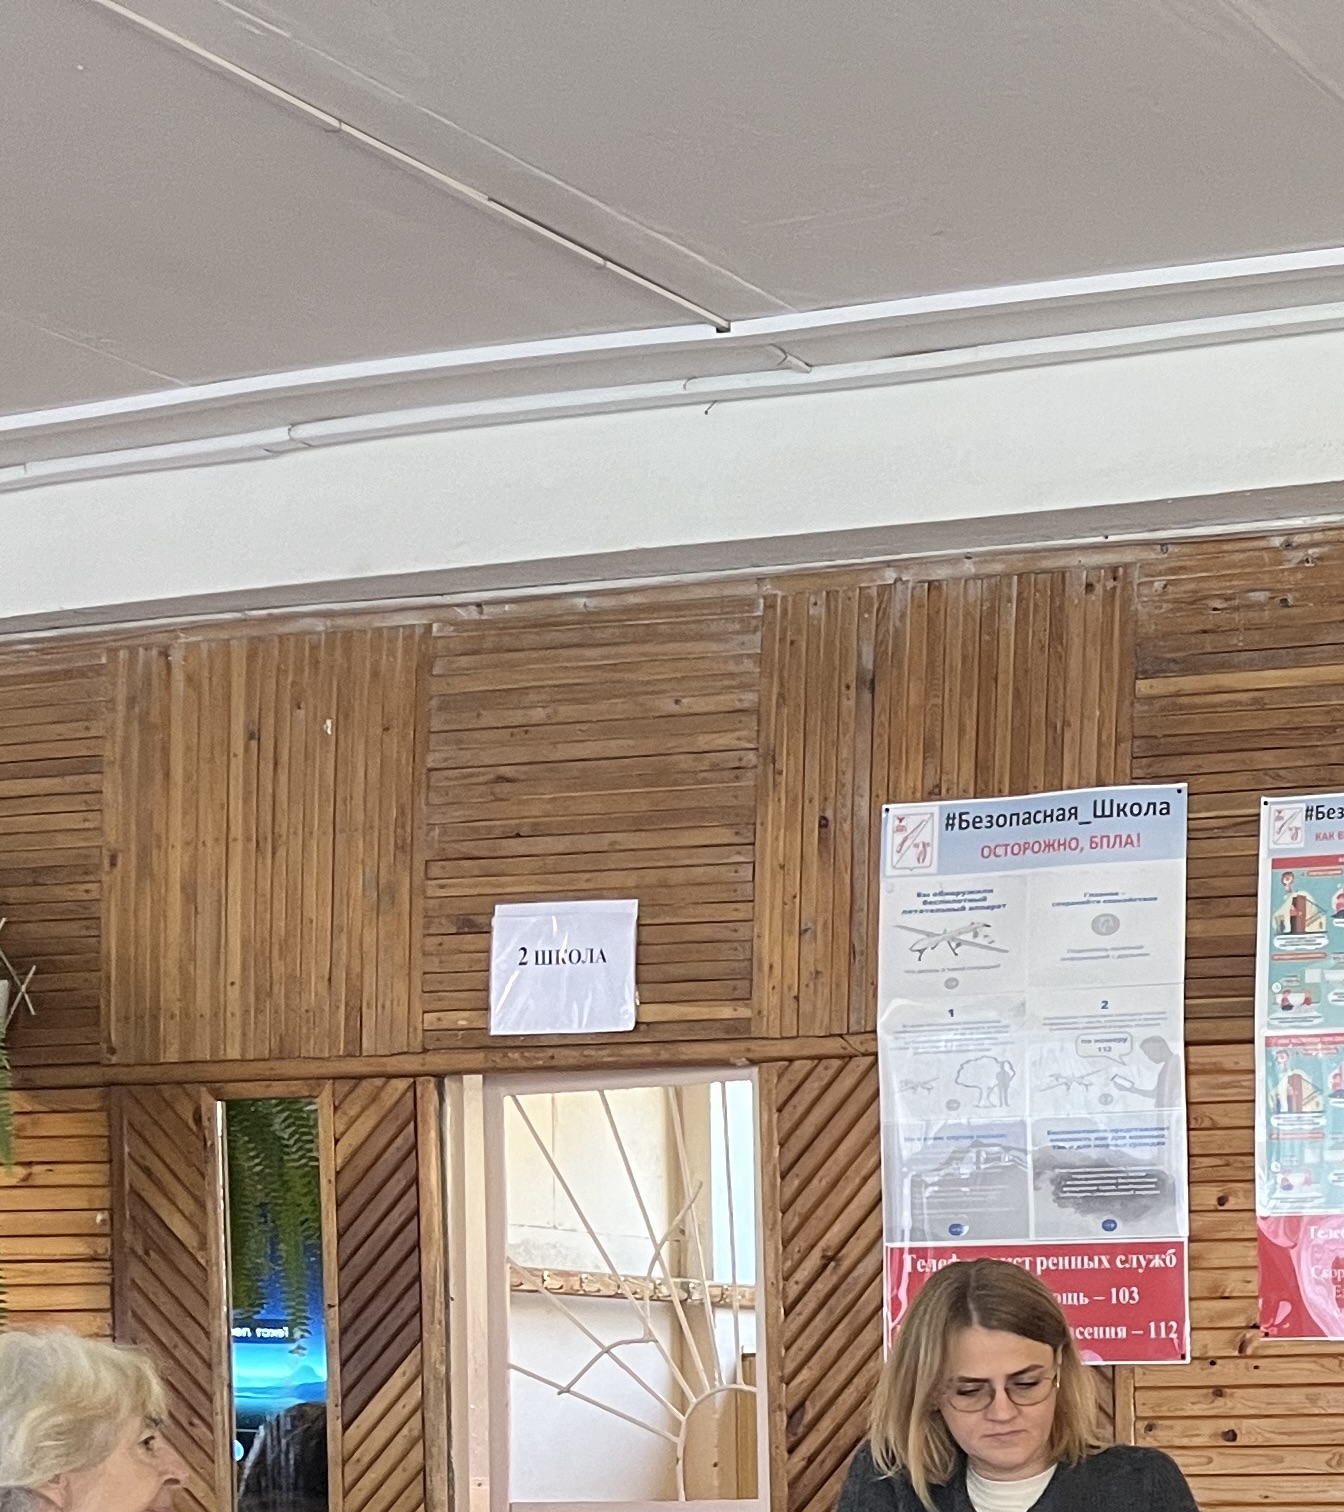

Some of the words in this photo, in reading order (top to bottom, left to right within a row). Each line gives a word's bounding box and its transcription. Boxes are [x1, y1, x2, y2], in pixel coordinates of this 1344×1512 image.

[945, 798, 1171, 831] #Безопасная_Школа
[980, 836, 1084, 859] ОСТОРОЖНО,
[1089, 832, 1141, 850] БПЛА!
[1315, 831, 1335, 842] КАК
[518, 946, 528, 966] 2
[534, 947, 607, 966] ШКОЛА
[947, 1008, 955, 1018] 1
[1100, 1000, 1109, 1010] 2
[903, 1253, 960, 1273] Теле
[1115, 1249, 1177, 1275] служб
[1053, 1292, 1089, 1306] ощь
[1110, 1286, 1140, 1304] 103
[1068, 1326, 1127, 1340] сения
[1149, 1320, 1178, 1339] 112
